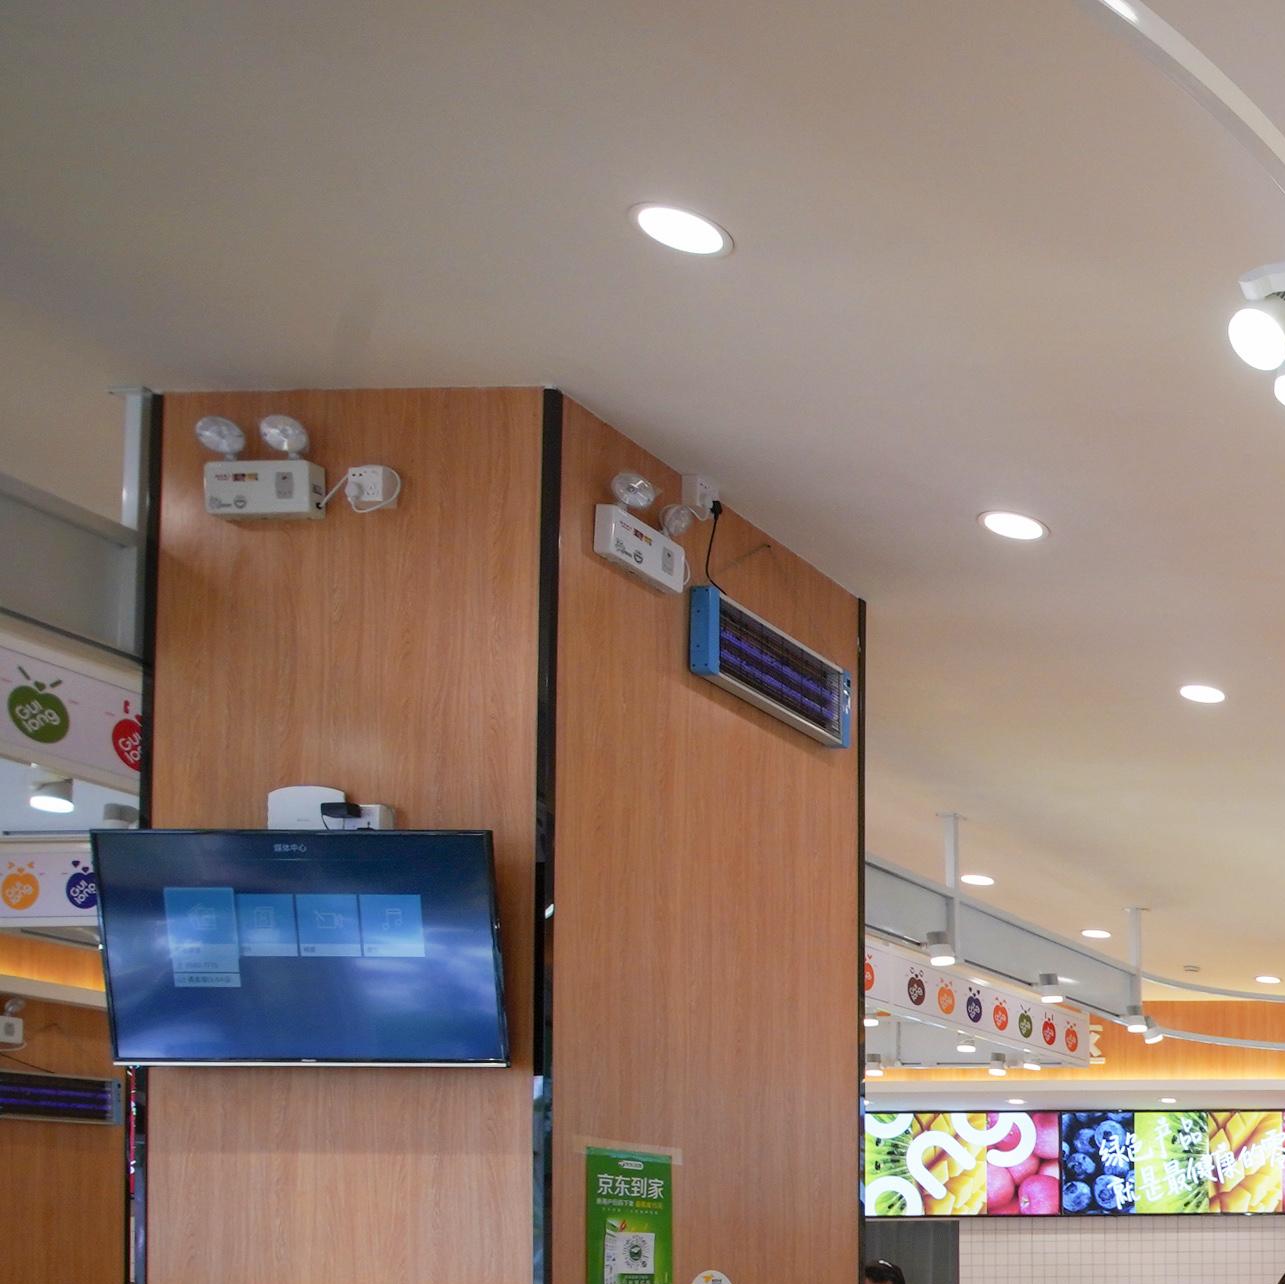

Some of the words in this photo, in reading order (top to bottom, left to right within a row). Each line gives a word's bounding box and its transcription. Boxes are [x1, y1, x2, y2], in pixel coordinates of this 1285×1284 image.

[16, 700, 42, 720] Gui
[23, 709, 60, 733] long
[124, 747, 141, 763] lo
[597, 1174, 664, 1200] 京东到家
